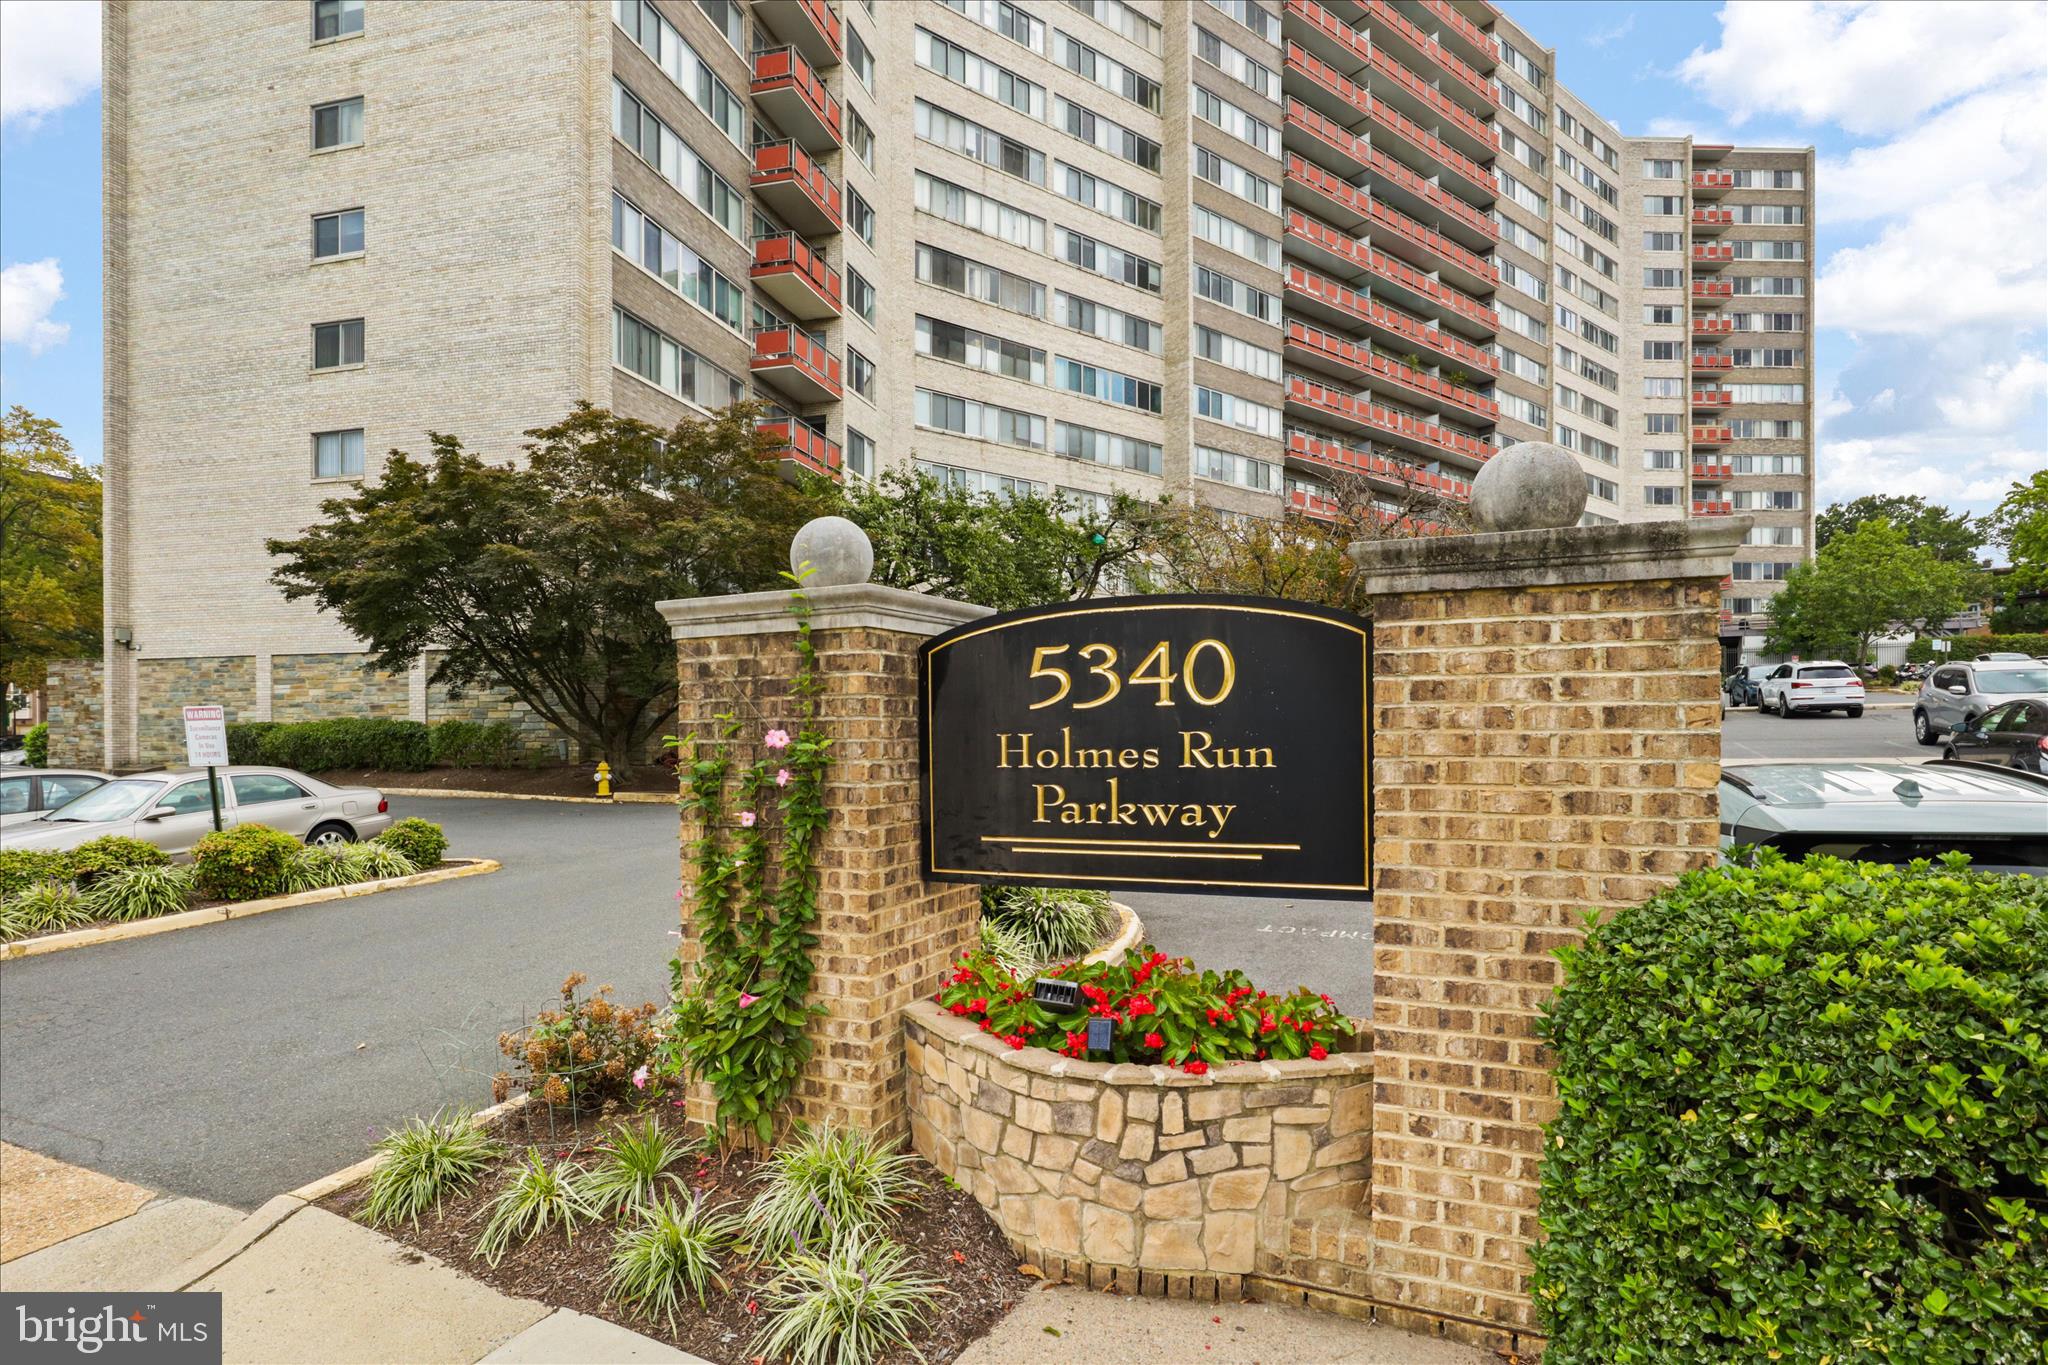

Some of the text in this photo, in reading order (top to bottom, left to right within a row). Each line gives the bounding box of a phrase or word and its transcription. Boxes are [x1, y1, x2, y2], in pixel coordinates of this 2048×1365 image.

[1028, 638, 1236, 710] 5340
[186, 709, 221, 719] WARNING
[995, 726, 1278, 770] Holmes Run
[1031, 776, 1238, 839] Parkway
[1256, 924, 1375, 940] OMPACT
